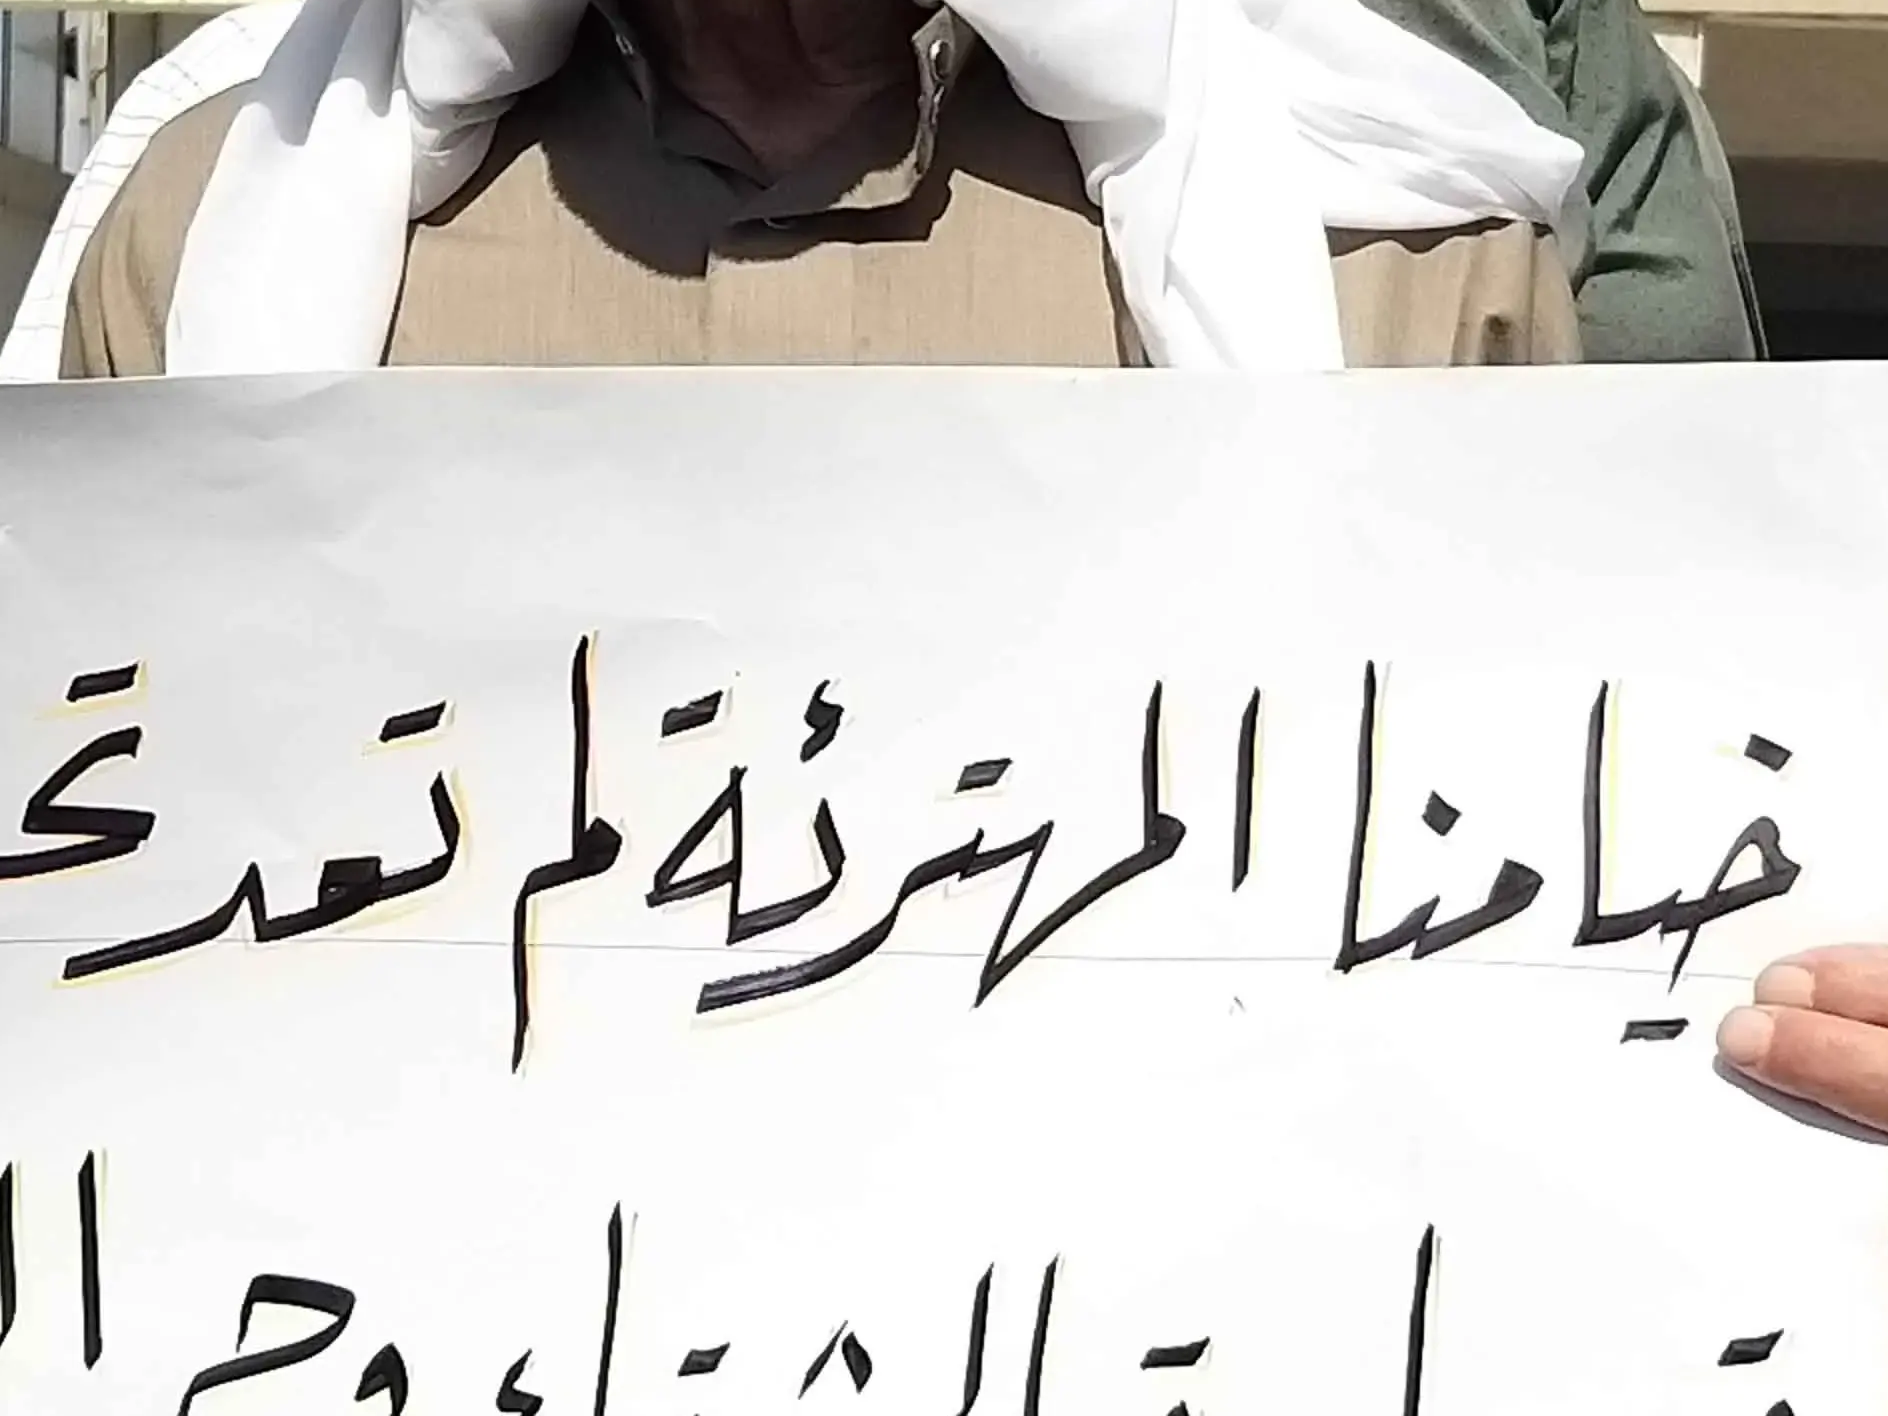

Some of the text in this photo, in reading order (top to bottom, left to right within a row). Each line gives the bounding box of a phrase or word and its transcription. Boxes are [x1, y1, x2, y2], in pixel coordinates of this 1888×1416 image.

[62, 700, 459, 981] تعد
[511, 634, 623, 1075] لم
[645, 679, 1261, 1015] المهترئة
[1333, 659, 1803, 1045] خيامنا
